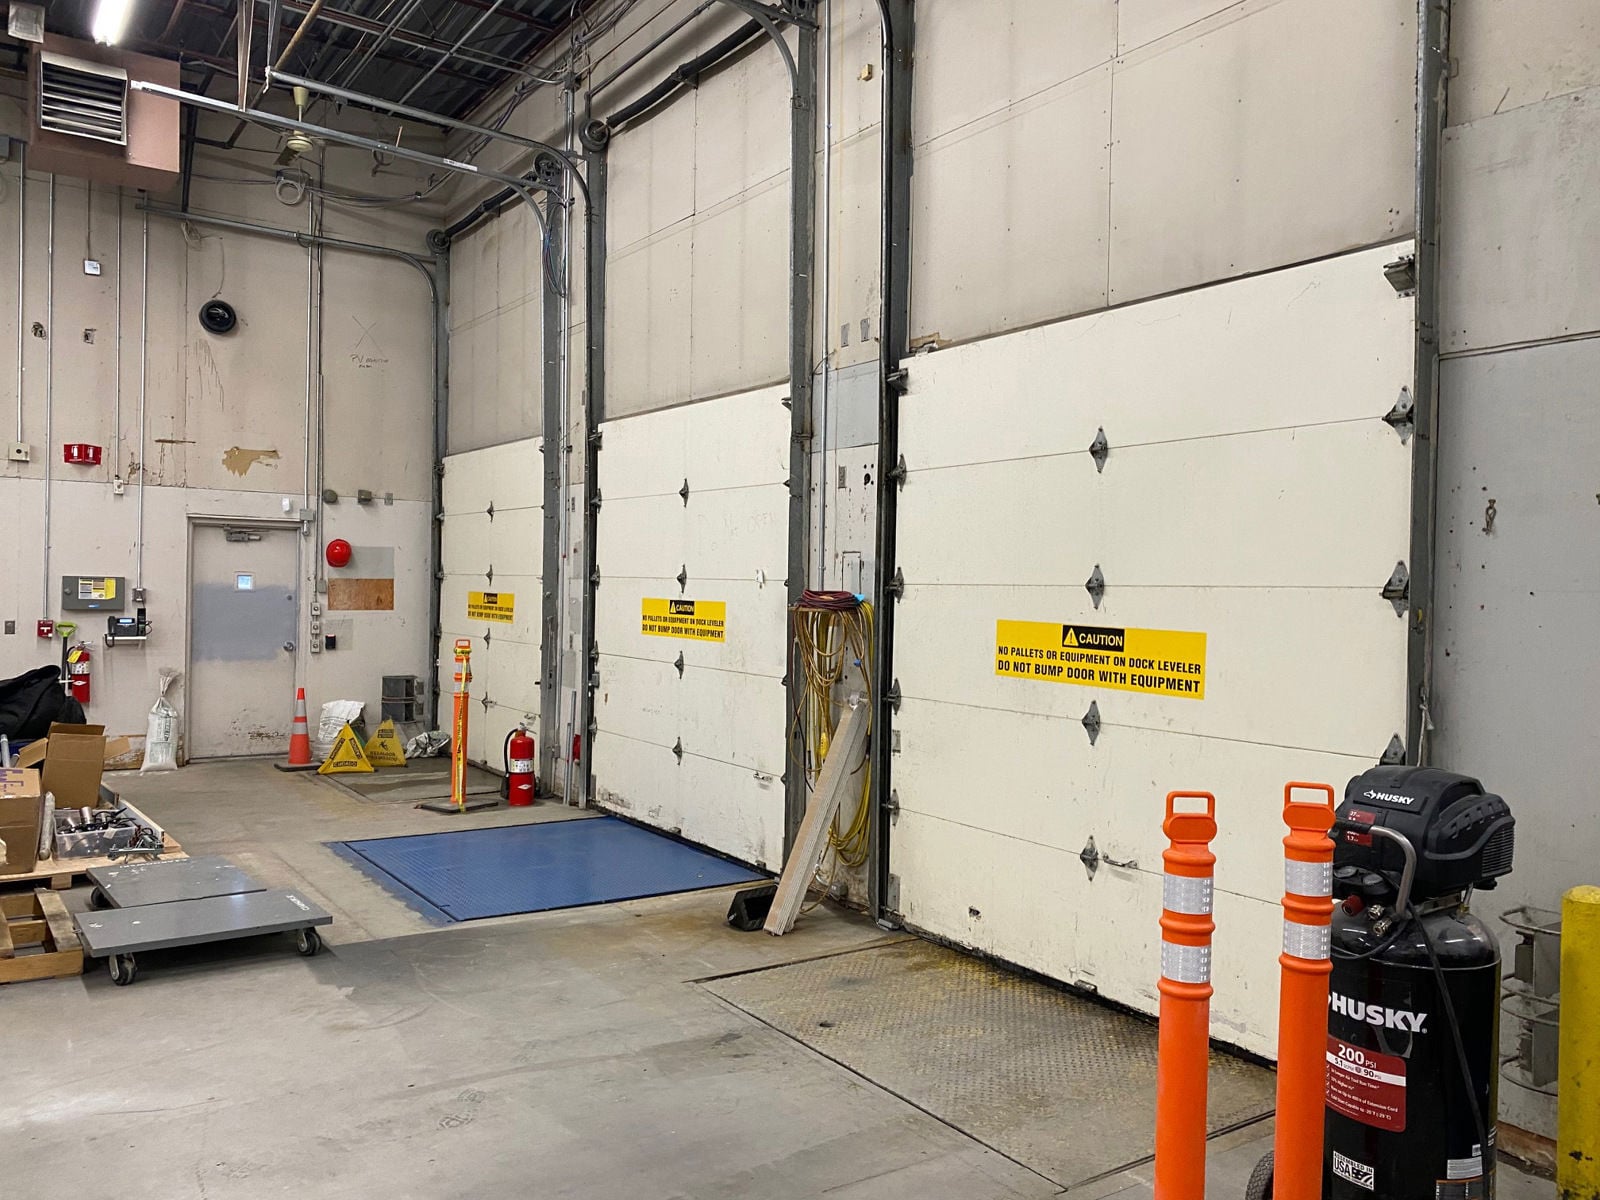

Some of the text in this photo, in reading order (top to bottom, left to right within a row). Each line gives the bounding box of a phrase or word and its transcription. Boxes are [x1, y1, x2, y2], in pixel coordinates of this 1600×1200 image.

[676, 604, 694, 612] CAUTION
[649, 624, 657, 632] NOT
[658, 625, 670, 633] BUMP
[671, 626, 683, 634] DOOR
[684, 627, 695, 635] WITH
[696, 628, 723, 638] EQUIPMENT
[1079, 632, 1123, 647] CAUTION
[998, 646, 1201, 674] NO PALLETS OR EQUIPMENT ON DOCK LEVELER
[998, 660, 1200, 693] DO NOT BUMP DOOR WITH EQUIPMENT
[1376, 792, 1414, 805] HUSKY
[1332, 992, 1427, 1033] HUSKY
[1338, 1044, 1376, 1069] 200 PSI
[1334, 1058, 1343, 1067] 5.1
[1363, 1069, 1374, 1078] 90
[1335, 1157, 1351, 1177] USA
